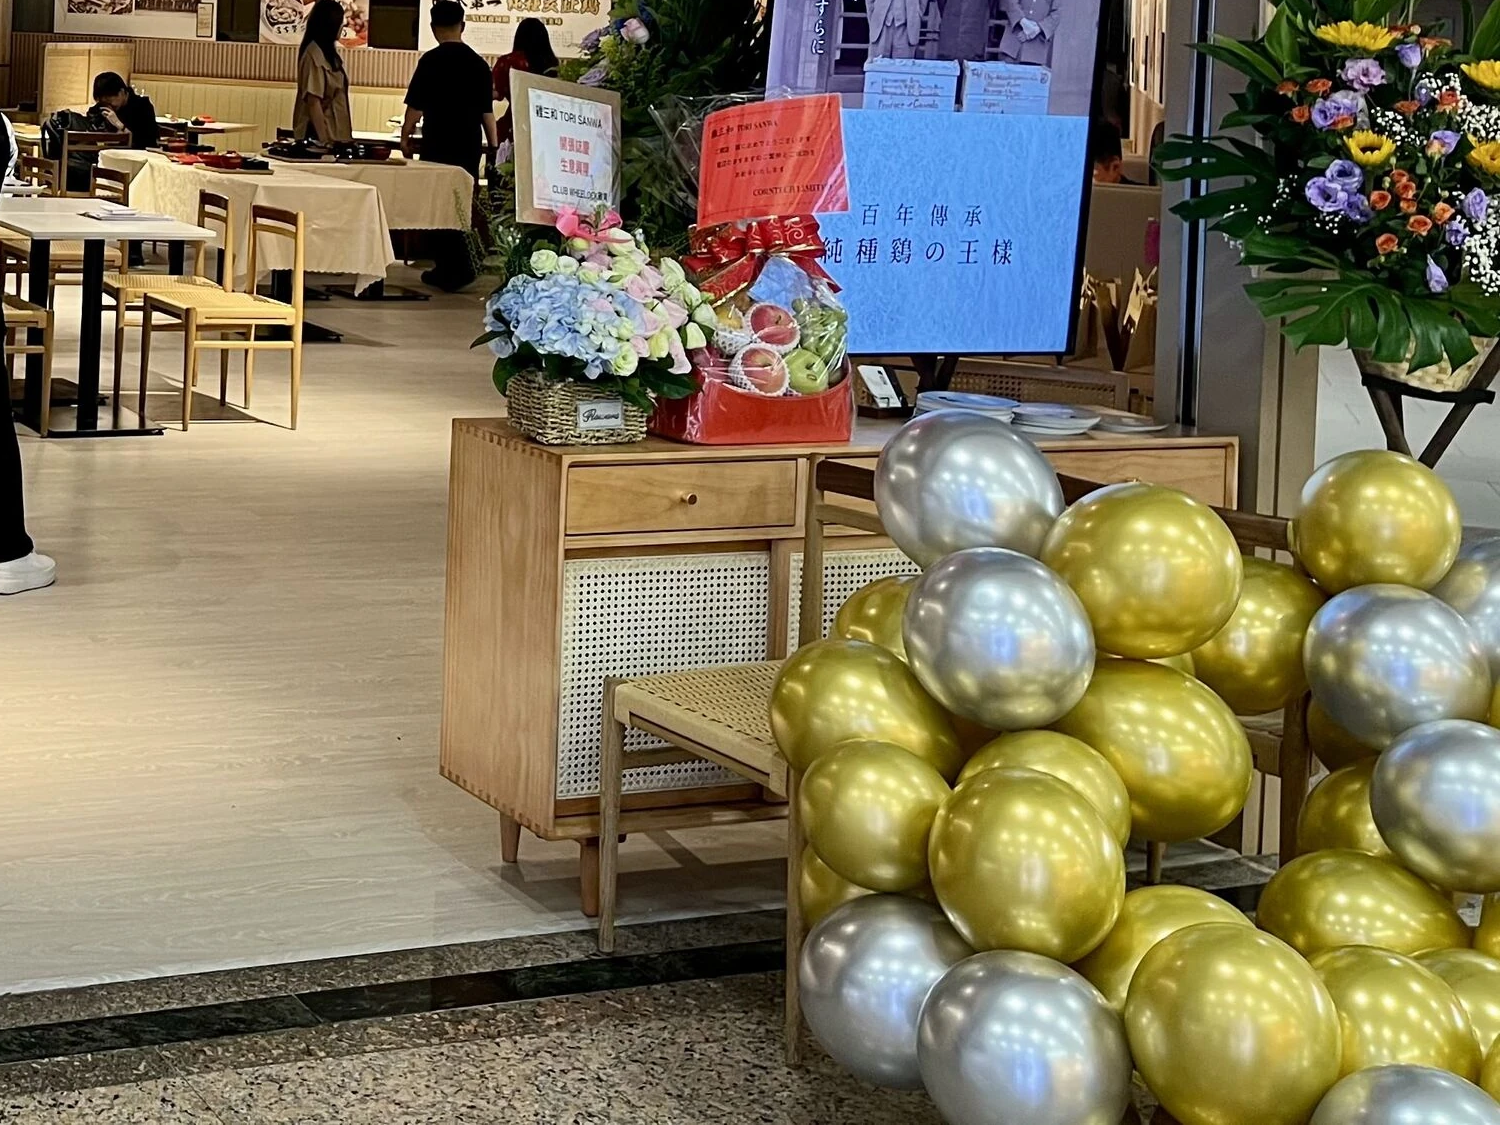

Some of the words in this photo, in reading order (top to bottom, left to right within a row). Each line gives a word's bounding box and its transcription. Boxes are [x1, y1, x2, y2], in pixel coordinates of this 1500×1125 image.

[560, 111, 576, 125] TORI
[577, 116, 602, 129] SANWA
[552, 184, 569, 196] CLUB
[861, 202, 982, 227] 百年傳承
